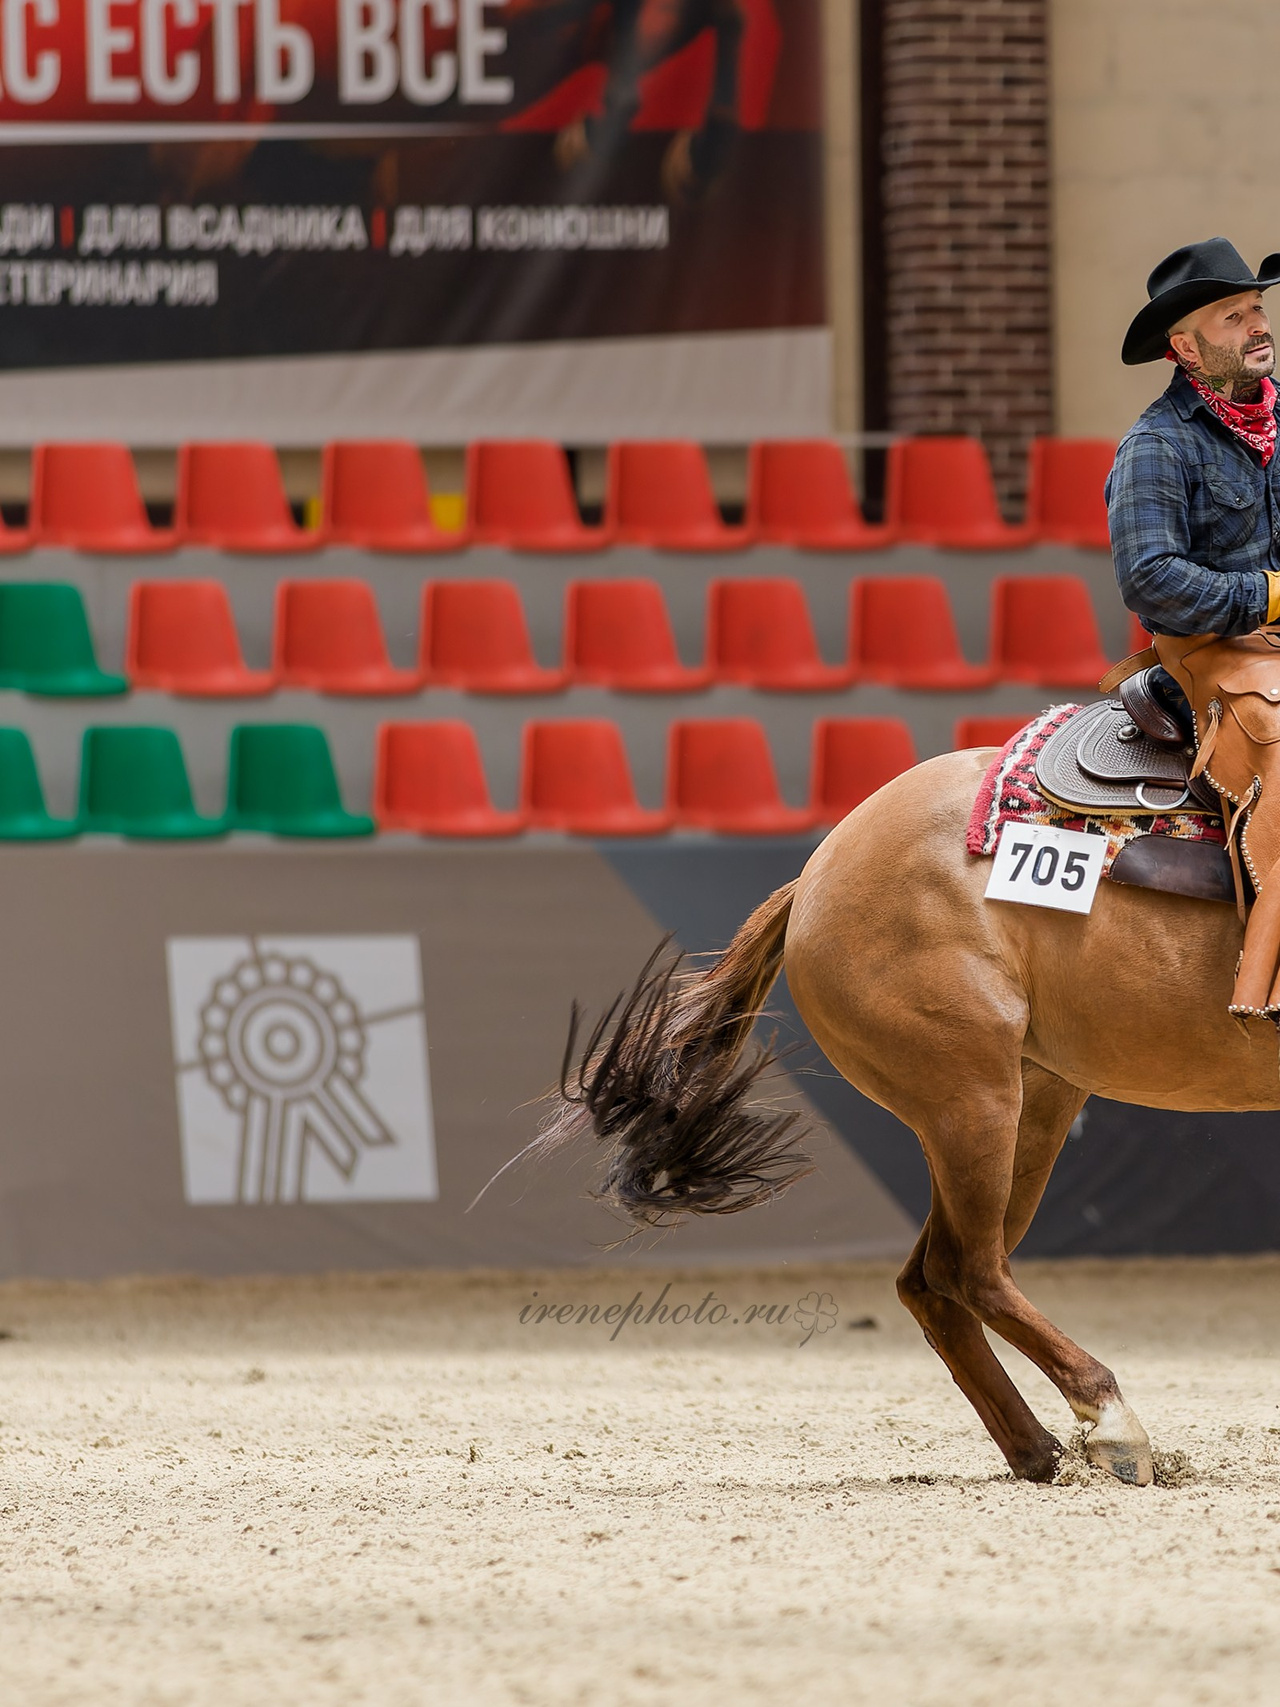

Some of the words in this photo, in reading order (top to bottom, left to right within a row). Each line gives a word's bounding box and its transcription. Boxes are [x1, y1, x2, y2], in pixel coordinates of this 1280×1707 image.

[0, 0, 60, 104] С
[86, 0, 314, 104] ЕСТЬ
[338, 0, 514, 105] ВСЕ
[78, 204, 160, 256] ДЛЯ
[166, 204, 367, 256] ВСАДНИКА
[389, 205, 472, 257] ДЛЯ
[1008, 842, 1090, 892] 705
